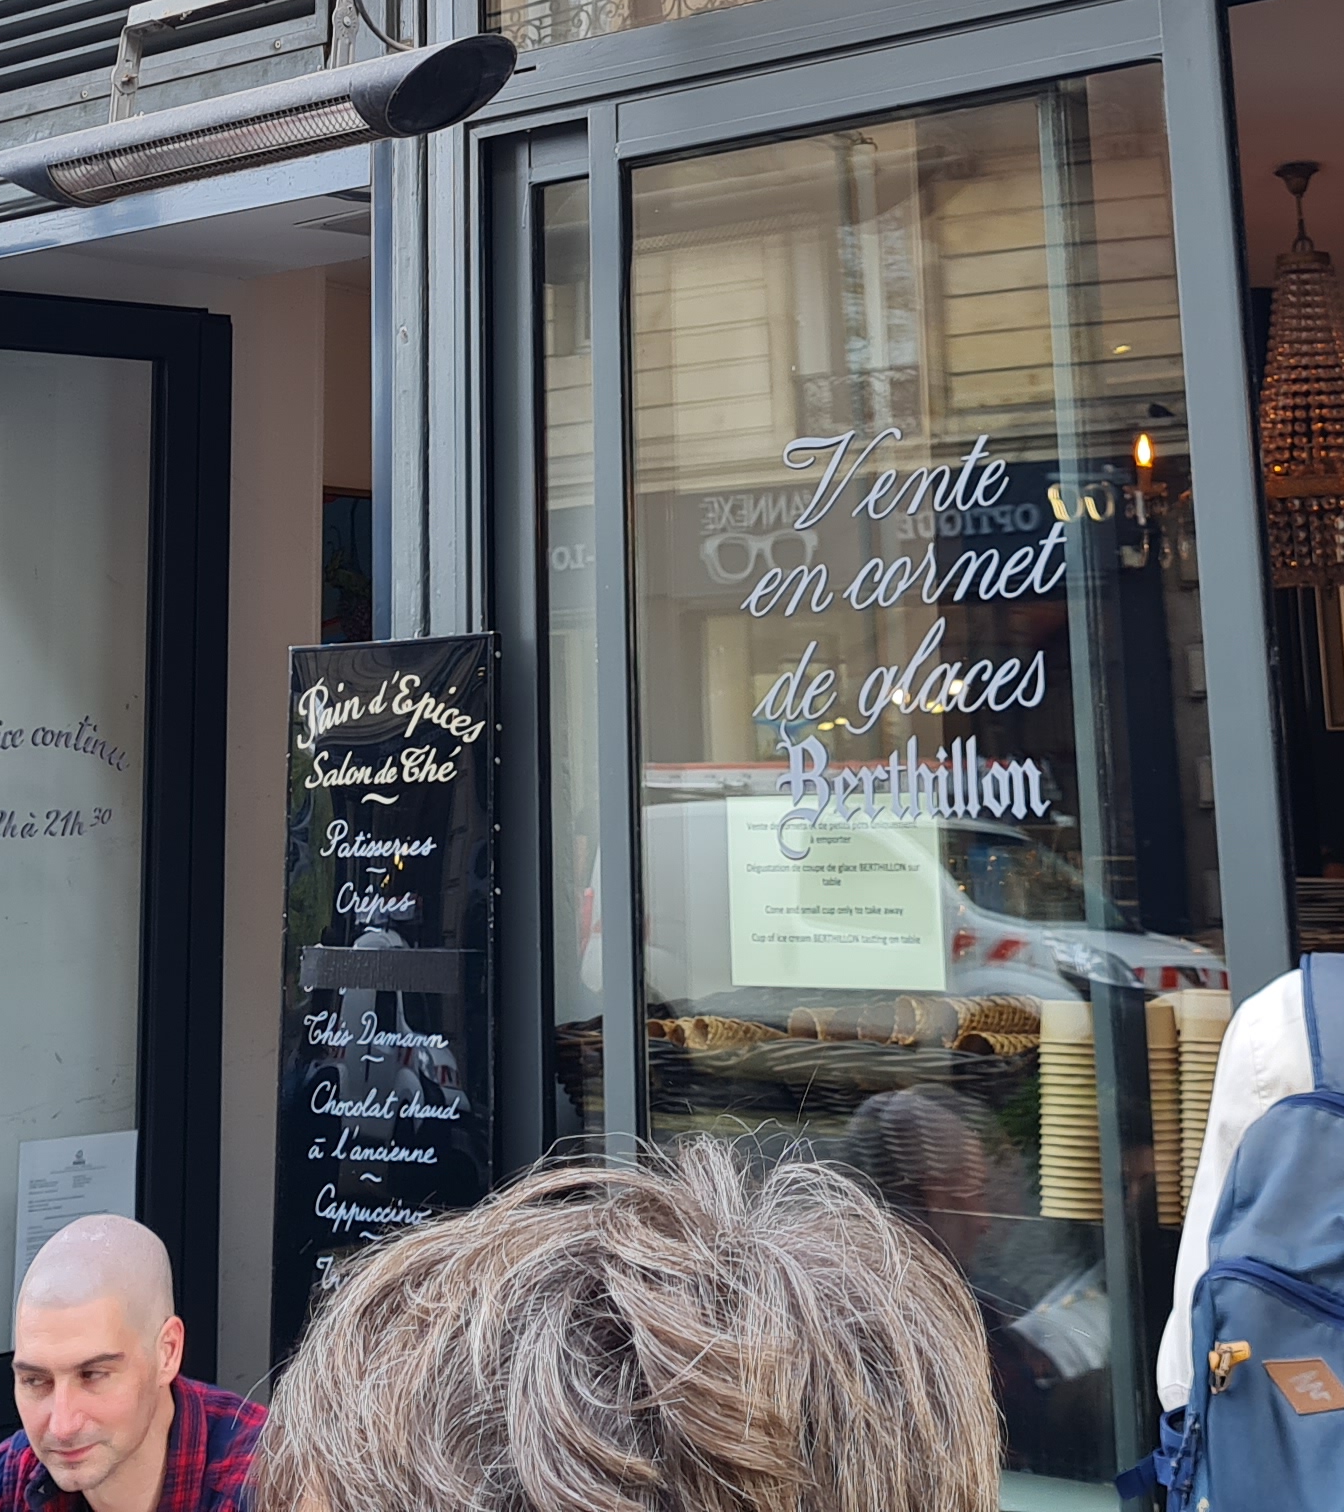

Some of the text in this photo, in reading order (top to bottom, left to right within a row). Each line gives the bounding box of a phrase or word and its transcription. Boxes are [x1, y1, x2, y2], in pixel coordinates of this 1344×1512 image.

[782, 427, 1009, 531] Vente
[740, 524, 1068, 617] en cornet
[753, 617, 1046, 735] de glaces
[32, 715, 130, 771] continu
[297, 677, 366, 749] Pain
[305, 745, 462, 788] Salon de Thé
[775, 719, 1052, 859] Berthillon
[336, 881, 416, 923] Crêpes
[311, 1081, 460, 1120] Chocolat chaud
[315, 1183, 431, 1233] Cappuccino
